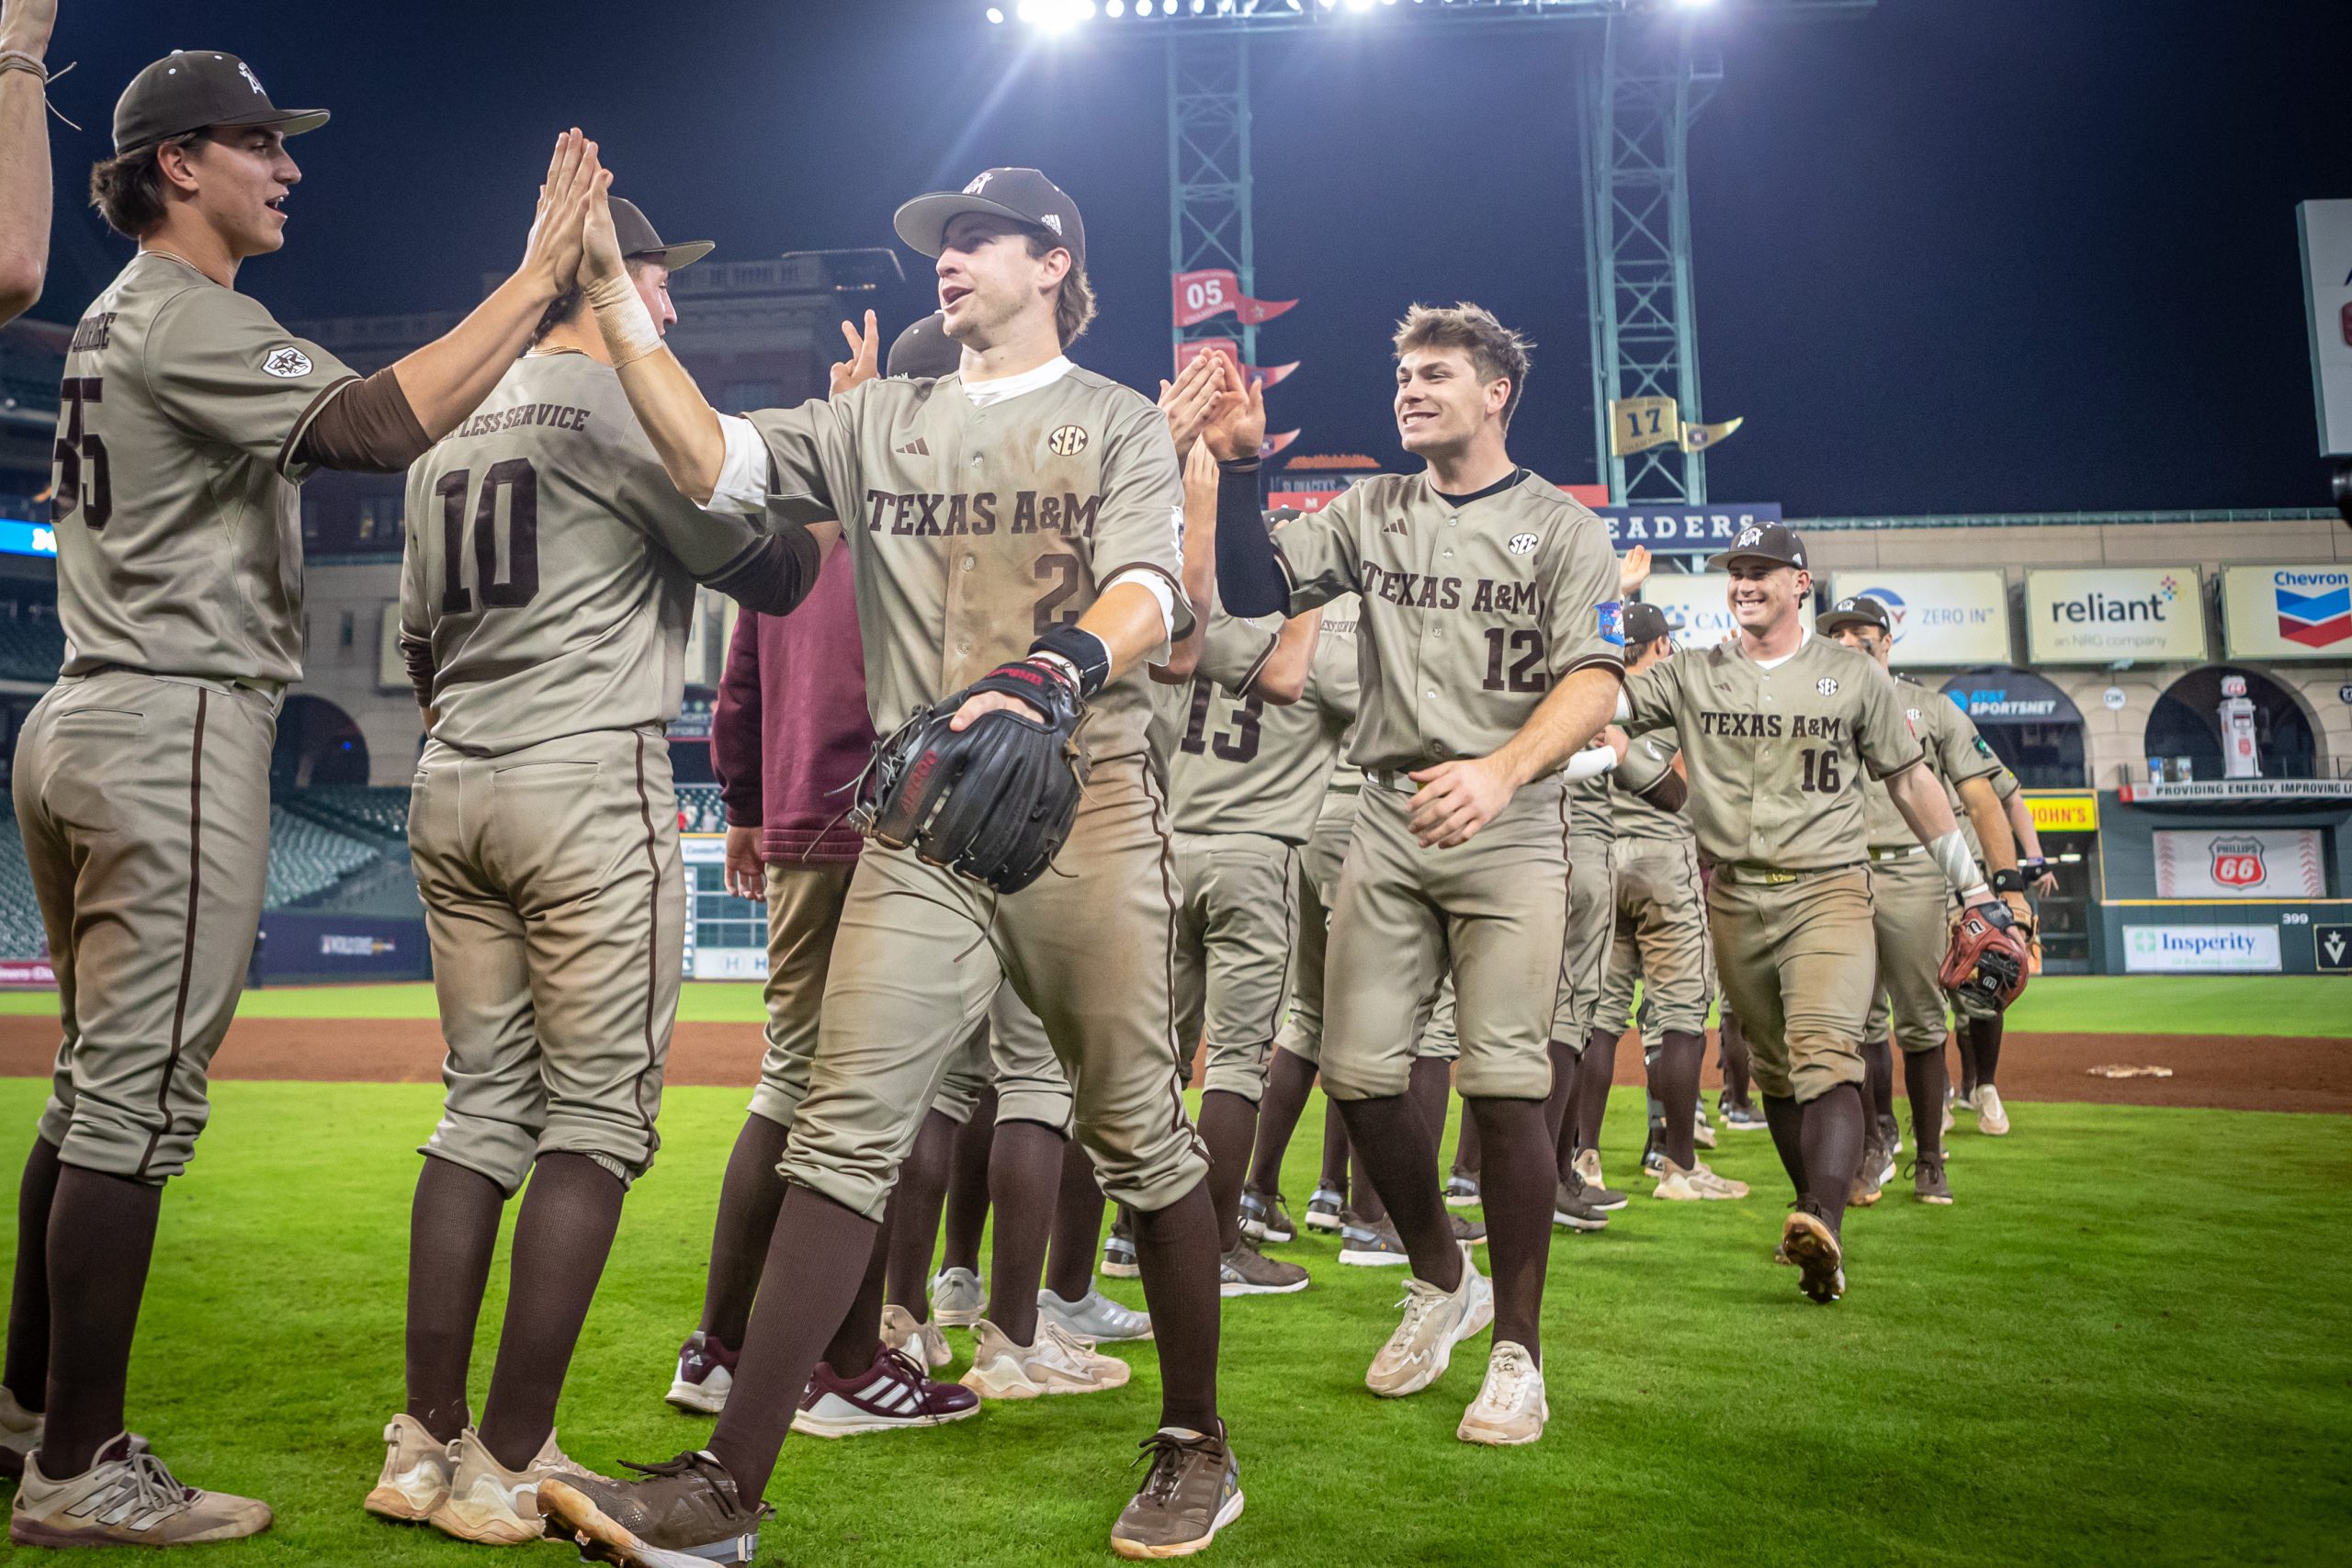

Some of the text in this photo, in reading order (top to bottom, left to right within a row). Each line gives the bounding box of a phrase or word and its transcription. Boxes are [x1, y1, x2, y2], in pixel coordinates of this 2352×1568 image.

[1187, 279, 1223, 310] 05
[503, 403, 591, 432] SERVICE
[1627, 408, 1662, 437] 17
[1049, 426, 1088, 456] SEC
[867, 489, 1100, 538] TEXAS A&M
[1604, 514, 1754, 539] EADERS
[435, 457, 539, 615] 10
[1510, 533, 1538, 555] SEC
[1362, 560, 1537, 615] TEXAS A&M
[2274, 571, 2349, 585] Chevron
[1034, 553, 1080, 636] 2
[2052, 593, 2165, 622] reliant
[1922, 609, 1964, 624] ZERO
[2073, 634, 2103, 647] NRG
[2107, 636, 2166, 649] company
[1483, 627, 1546, 693] 12
[1816, 677, 1838, 696] SEC
[1180, 674, 1264, 763] 13
[1970, 701, 2057, 716] SPORTSNET
[1700, 712, 1841, 741] TEXAS A&M
[1801, 749, 1841, 794] 16
[2156, 784, 2223, 796] PROVIDING
[2228, 784, 2278, 795] ENERGY.
[2281, 784, 2341, 794] IMPROVING
[2216, 843, 2258, 854] PHILLIPS
[2221, 858, 2255, 880] 66
[2281, 913, 2309, 925] 399
[2162, 932, 2256, 955] Insperity
